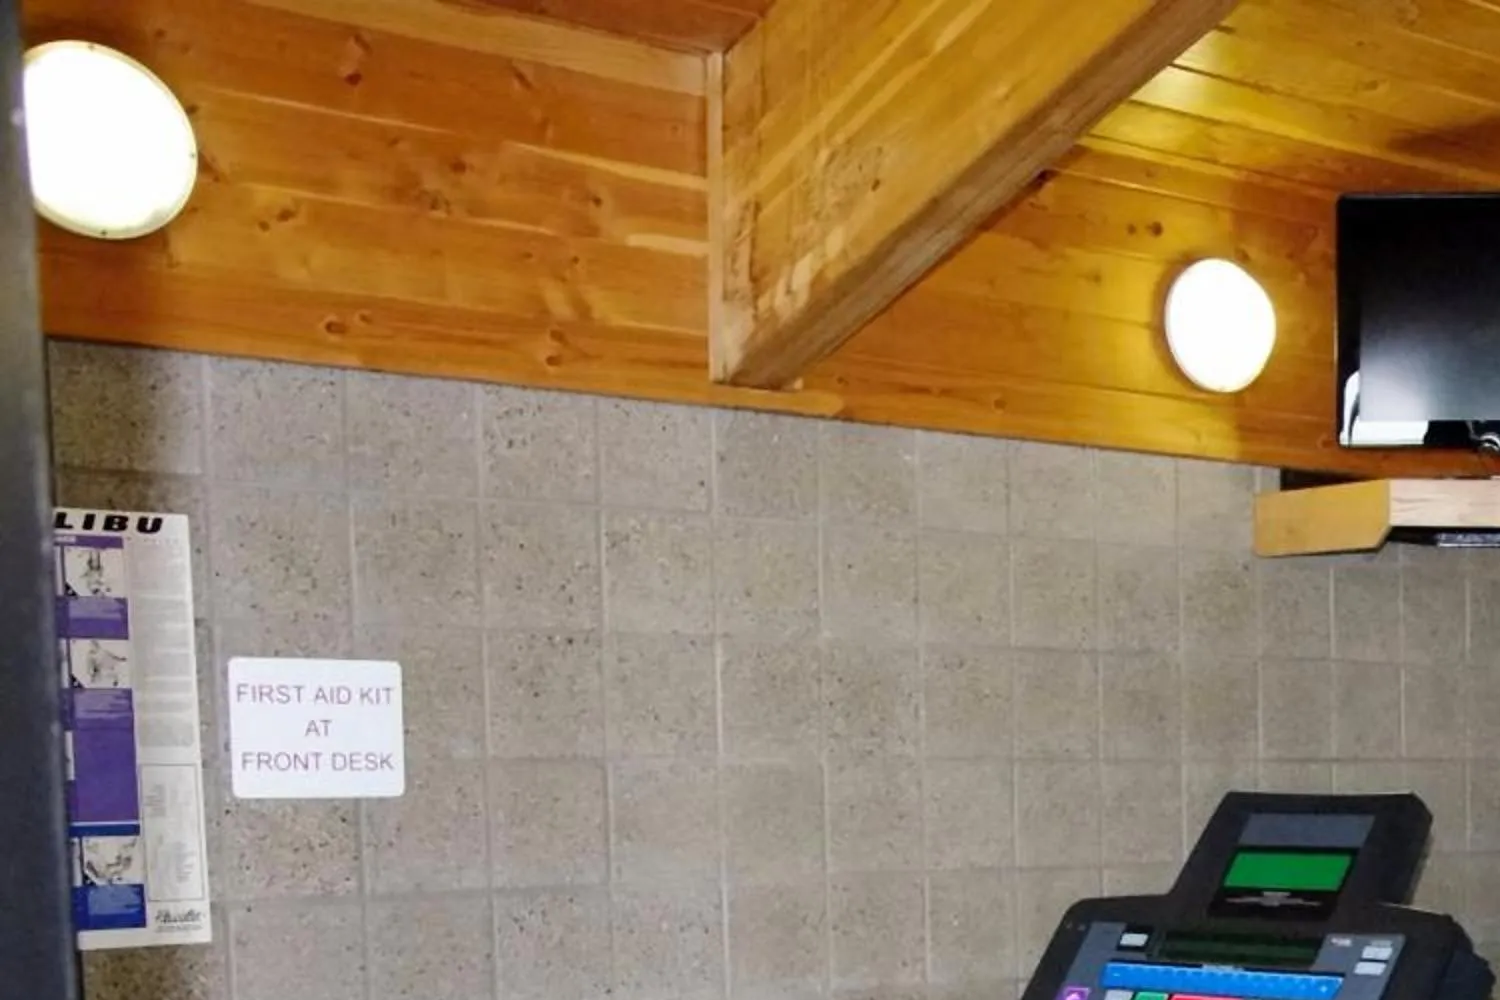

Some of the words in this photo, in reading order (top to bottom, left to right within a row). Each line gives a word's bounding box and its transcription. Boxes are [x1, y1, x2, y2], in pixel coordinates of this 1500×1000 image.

[54, 512, 163, 534] LIBU
[236, 683, 305, 705] FIRST
[314, 685, 352, 705] AID
[359, 687, 394, 705] KIT
[304, 719, 332, 737] AT
[241, 751, 323, 772] FRONT
[331, 752, 395, 772] DESK
